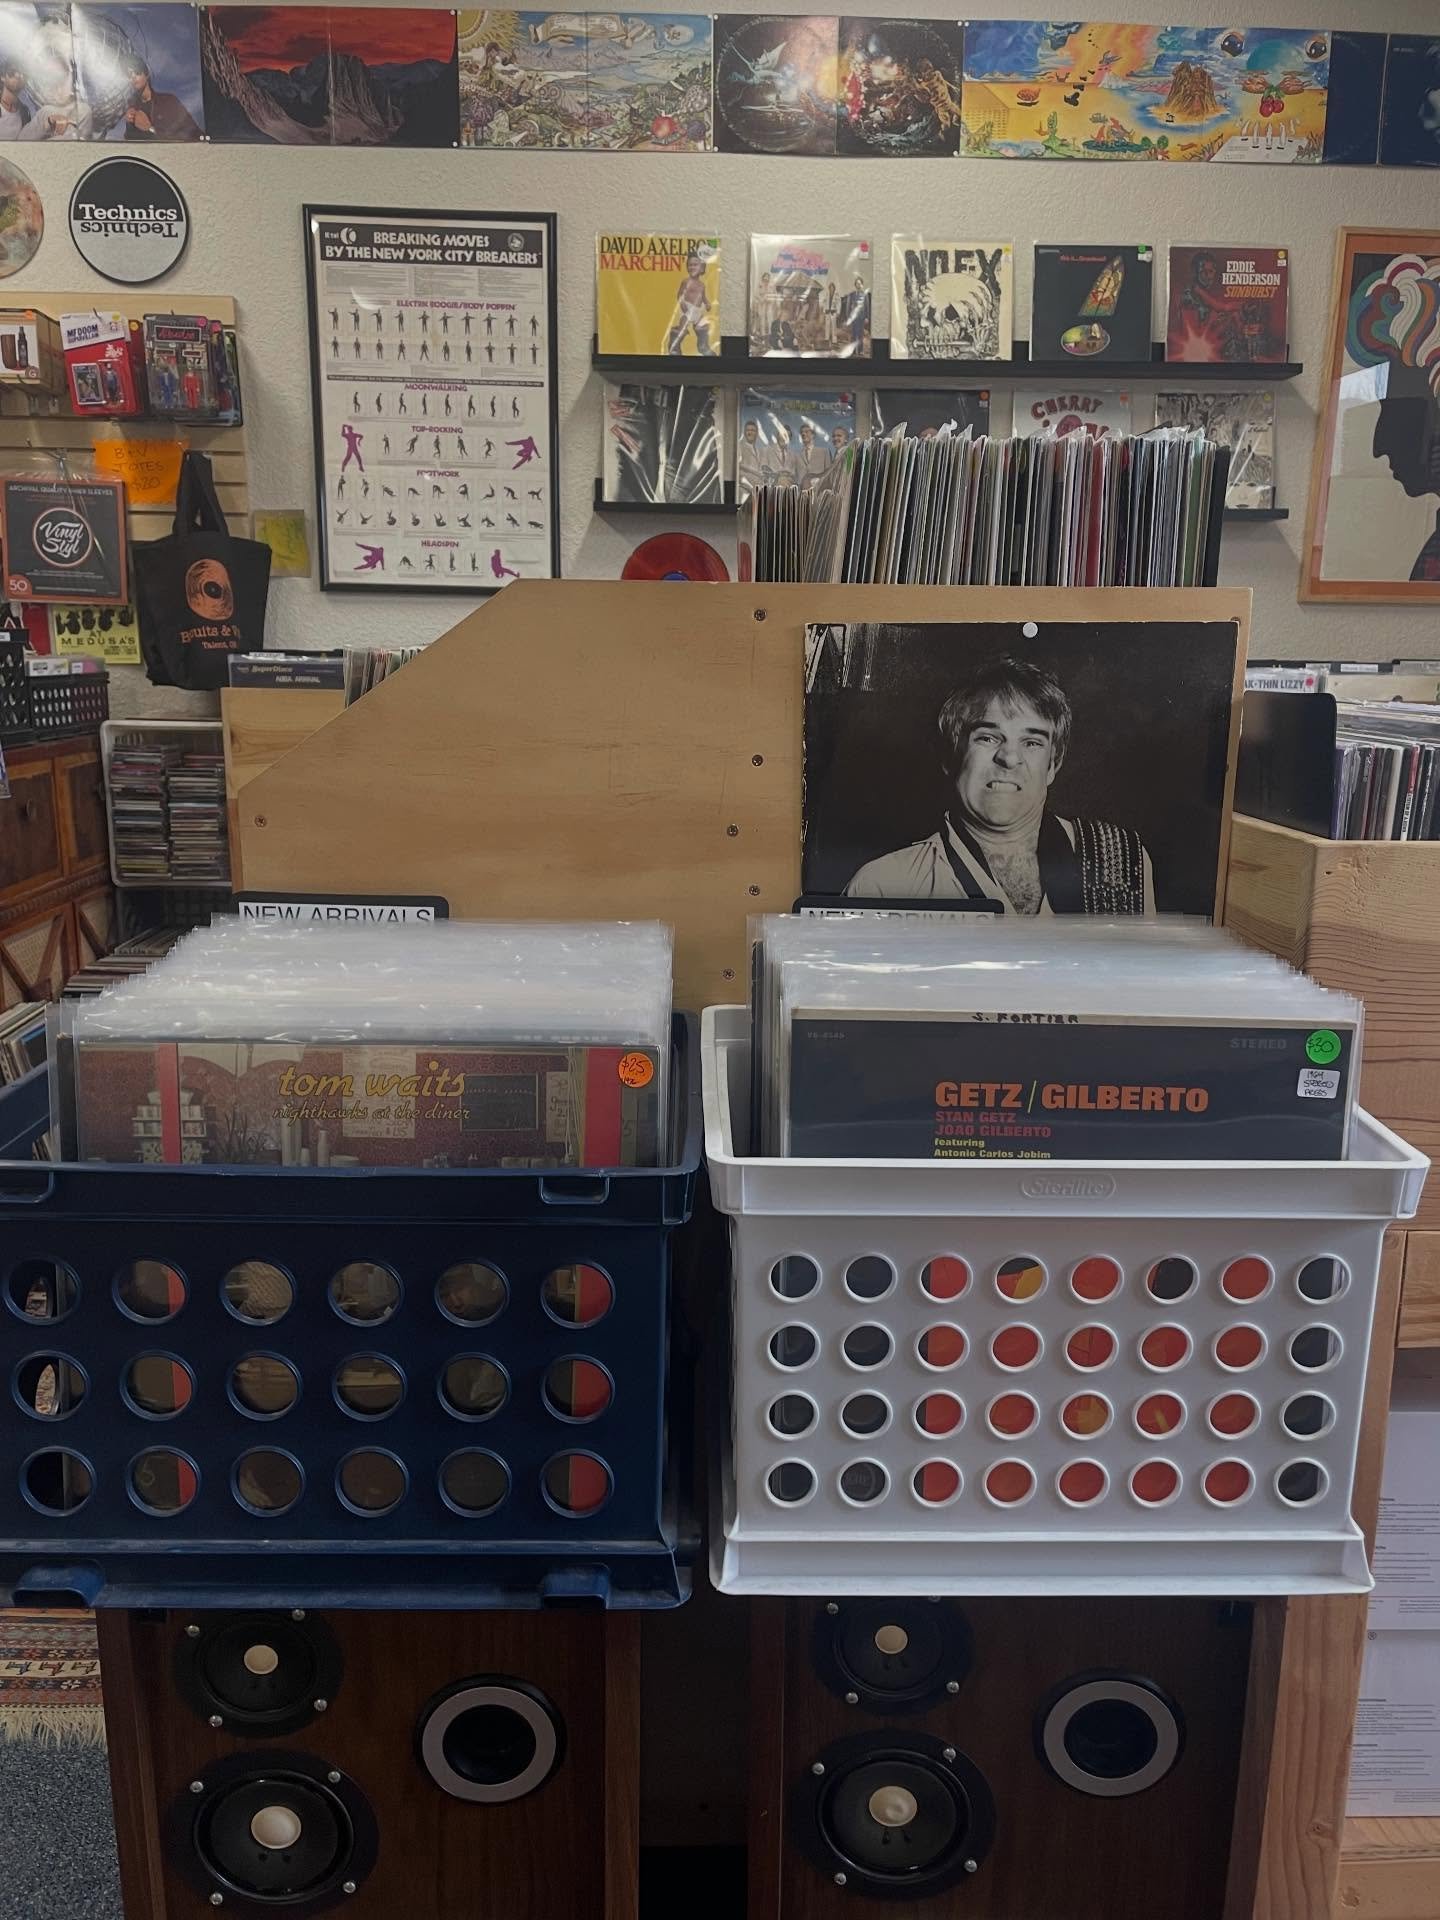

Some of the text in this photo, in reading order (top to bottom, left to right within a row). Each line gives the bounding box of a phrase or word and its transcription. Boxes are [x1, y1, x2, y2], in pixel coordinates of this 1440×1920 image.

[79, 204, 177, 220] Technics
[81, 222, 178, 238] Technics
[373, 232, 489, 248] BREAKING MOVES
[600, 236, 706, 256] DAVID AXELRO
[325, 246, 538, 264] BY THE NEW YORK CITY BREAKERS
[600, 254, 685, 272] MARCHIN'
[1226, 260, 1256, 273] EDDIE
[1222, 273, 1281, 286] HENDERSON
[1224, 286, 1278, 298] SUNBURST
[77, 323, 98, 336] DOOM
[404, 383, 467, 392] MOONWALKING
[1031, 395, 1103, 420] CHERRY
[416, 469, 460, 477] FOOTWORK
[40, 521, 84, 540] Vinyl
[41, 538, 80, 558] Styl
[9, 579, 28, 591] 50
[61, 636, 136, 645] MEDUSA'S
[1258, 680, 1280, 689] THIN
[1281, 680, 1305, 690] LIZZY
[243, 905, 431, 923] NEW ARRIVALS
[997, 1012, 1079, 1024] FORTIER
[1230, 1037, 1287, 1050] STEREO
[1308, 1037, 1334, 1054] $30
[622, 1056, 649, 1074] $25
[279, 1061, 466, 1097] tom waits
[273, 1100, 471, 1126] nighthawks at the diner
[935, 1111, 1016, 1123] STAN GETZ
[934, 1125, 1051, 1137] JOAO GILBERTO
[934, 1137, 985, 1148] featuring
[934, 1149, 1051, 1159] Antonio Carlos Jobim
